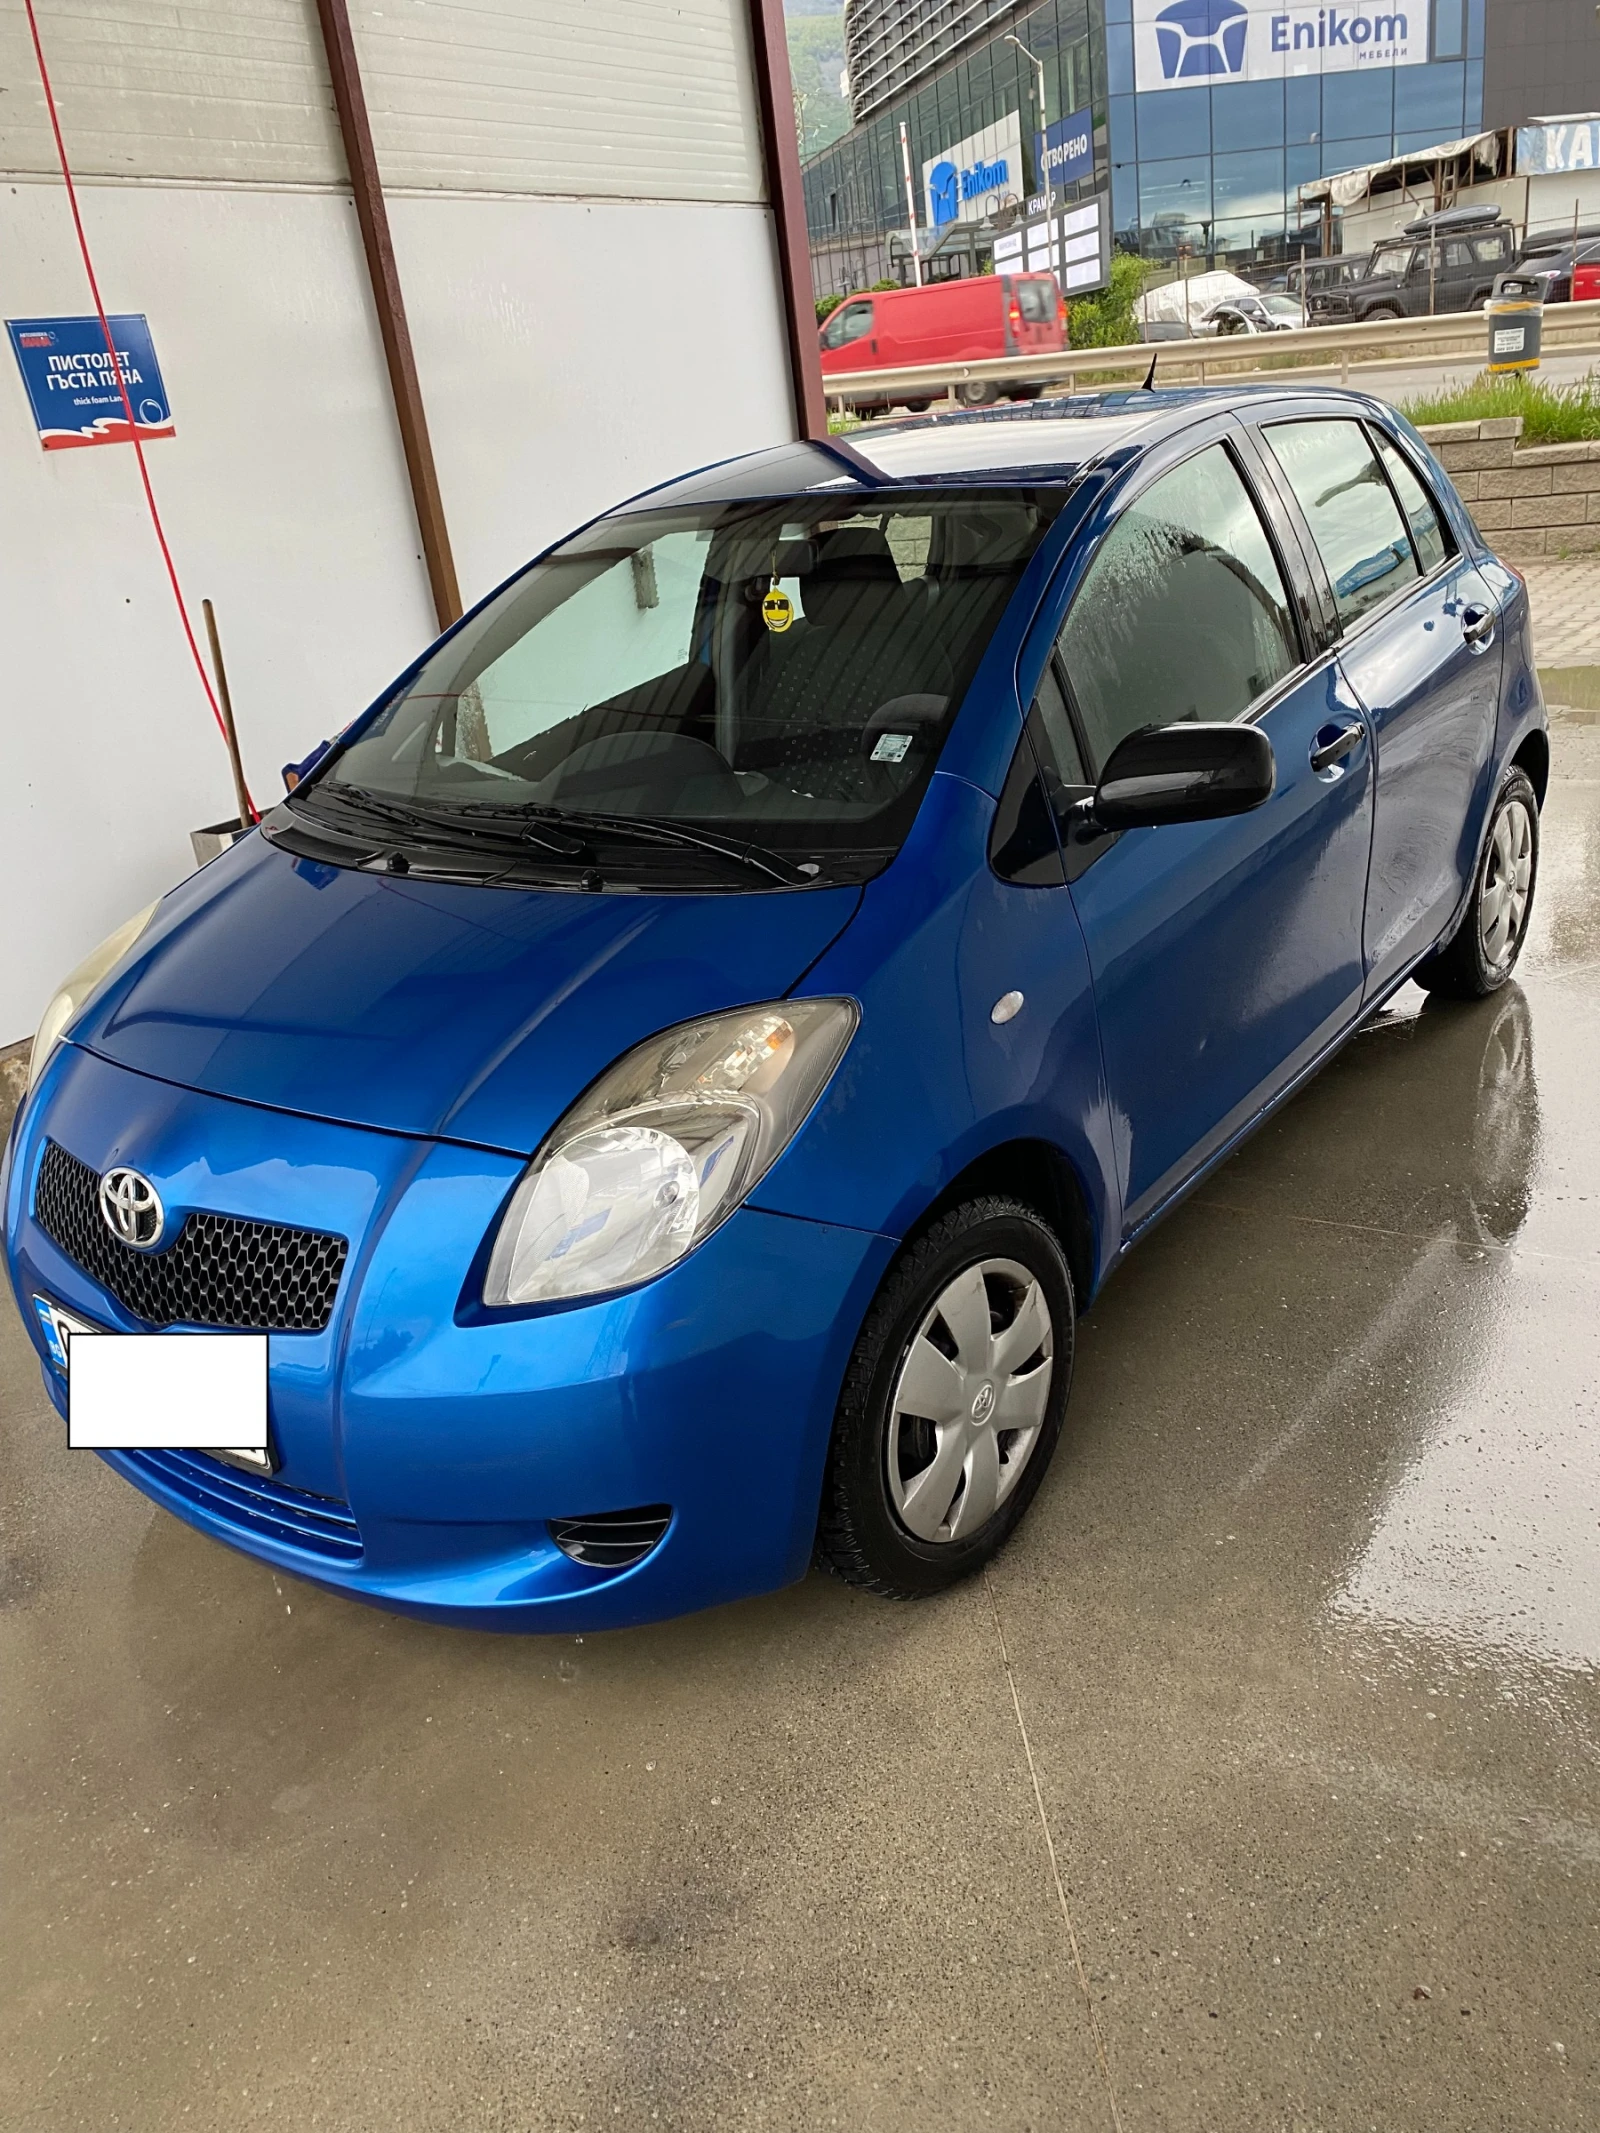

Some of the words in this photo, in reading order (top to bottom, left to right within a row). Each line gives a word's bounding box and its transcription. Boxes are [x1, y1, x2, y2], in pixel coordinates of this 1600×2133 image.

[1271, 9, 1408, 52] Enikom
[1359, 47, 1408, 60] МЕБЕЛИ
[1546, 124, 1600, 169] КА
[960, 159, 1009, 201] Enikom
[1028, 191, 1056, 215] КРАМР
[48, 351, 130, 372] ПИСТОЛЕТ
[46, 371, 100, 391] ГЪСТА
[98, 368, 144, 387] ПЯНА
[73, 397, 92, 406] thick
[91, 395, 109, 404] foam
